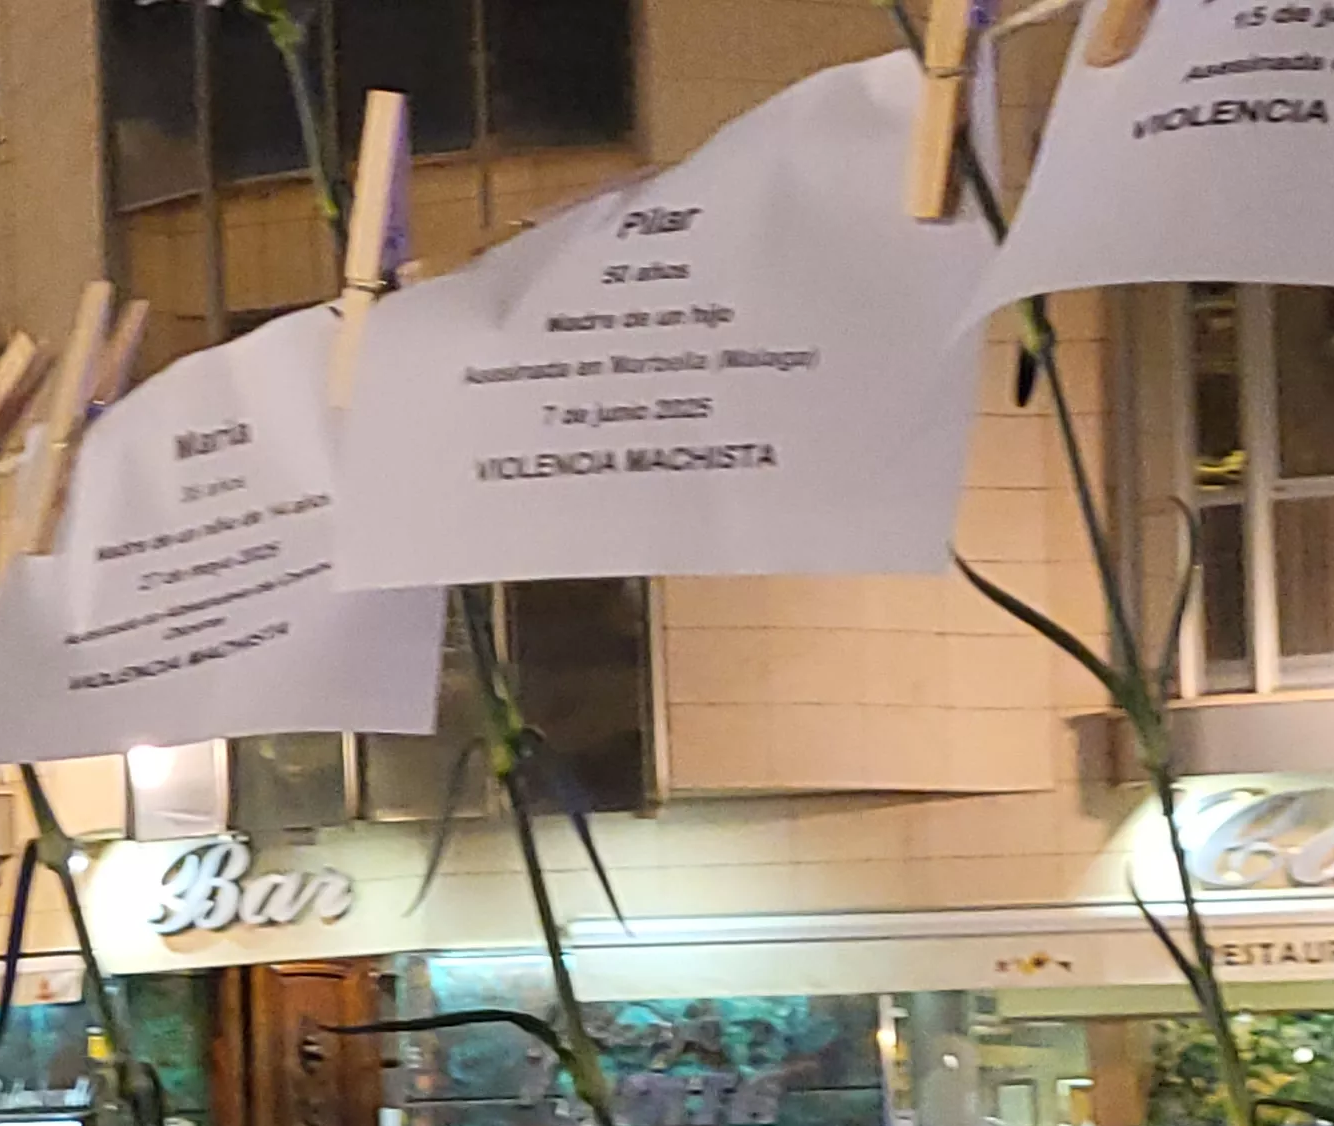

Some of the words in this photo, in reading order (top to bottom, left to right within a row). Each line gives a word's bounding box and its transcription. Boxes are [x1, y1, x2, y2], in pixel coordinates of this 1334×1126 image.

[1273, 2, 1311, 24] de
[1183, 51, 1325, 82] Asesinada
[1132, 97, 1329, 140] VIOLENCIA
[616, 205, 703, 239] Pilar
[476, 448, 618, 482] VIOLENCIA
[624, 442, 778, 474] MACHISTA
[67, 654, 181, 690] VIOLENCIA
[187, 620, 291, 666] MACHISTA
[148, 836, 357, 938] Bar
